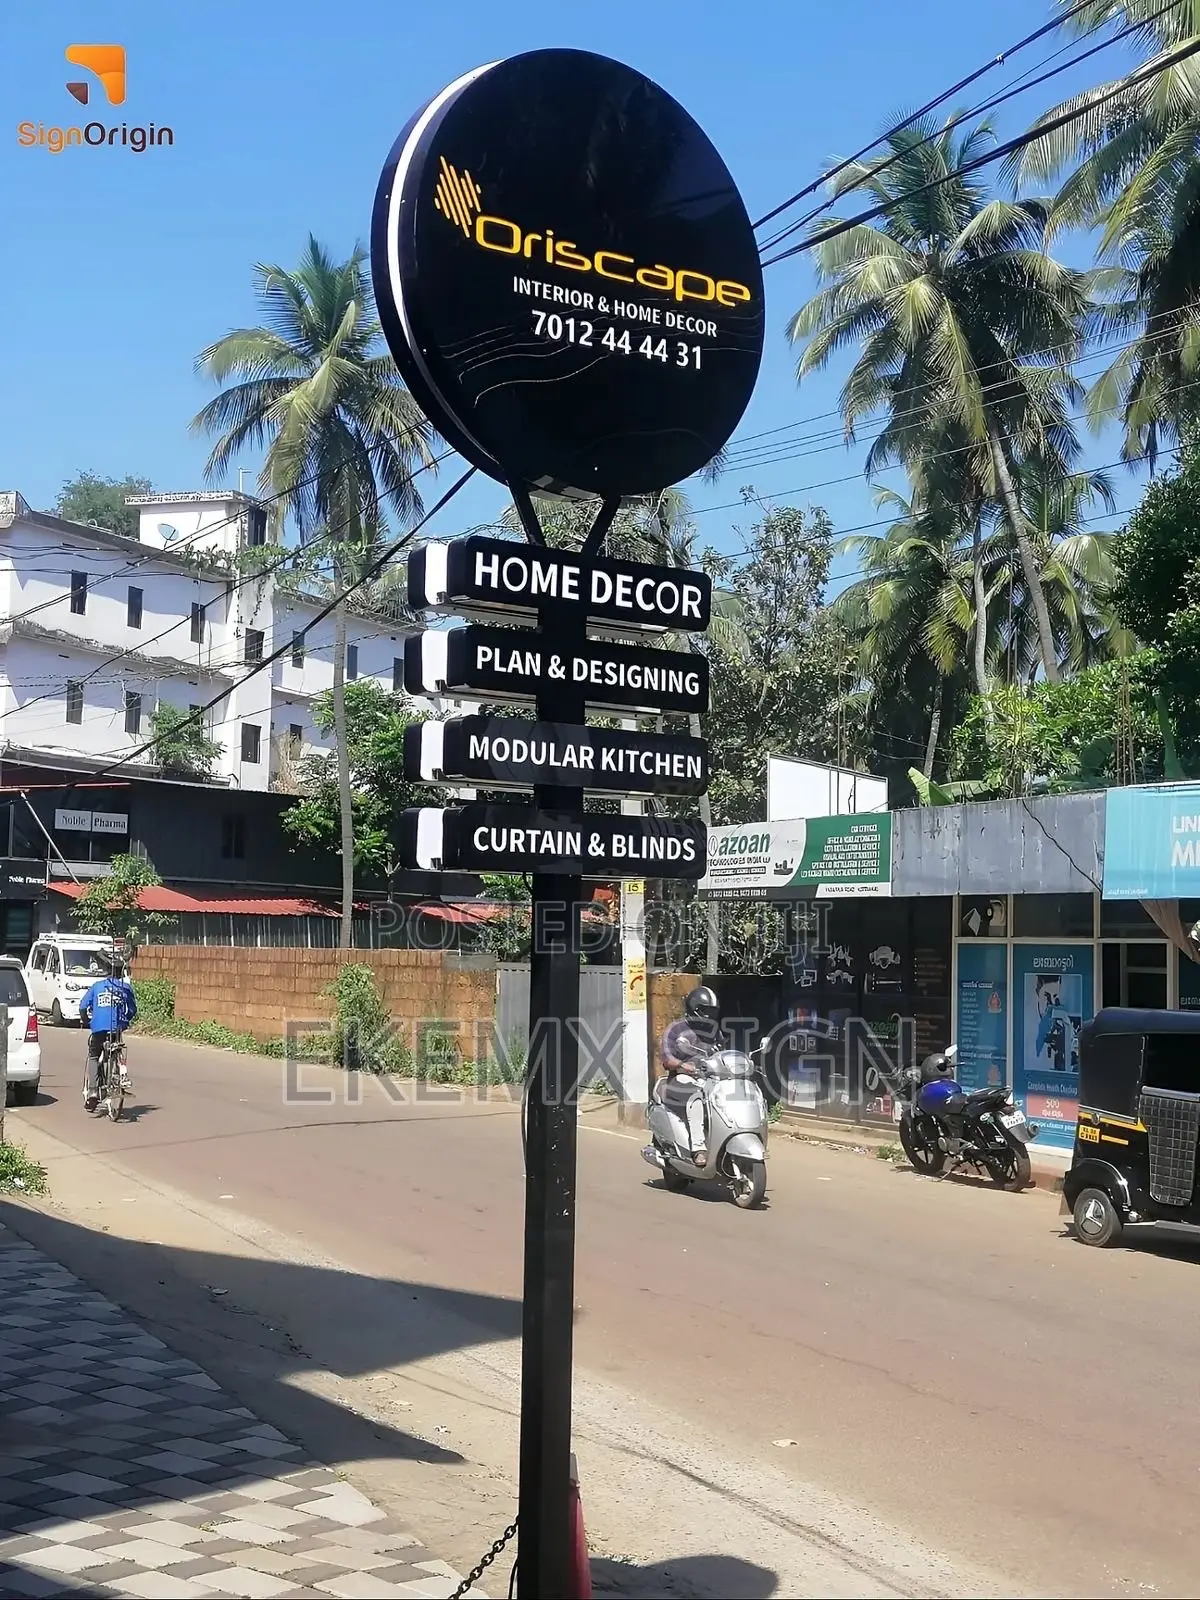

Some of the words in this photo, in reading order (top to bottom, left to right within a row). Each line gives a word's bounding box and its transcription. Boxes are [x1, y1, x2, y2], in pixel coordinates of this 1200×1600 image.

[475, 214, 752, 308] Oriscape
[512, 275, 594, 311] INTERIOR
[597, 295, 610, 314] &
[613, 299, 662, 325] HOME
[665, 311, 718, 338] DECOR
[531, 309, 594, 347] 7012
[601, 326, 632, 355] 44
[638, 334, 669, 363] 44
[675, 341, 702, 370] 31
[474, 551, 581, 601] HOME
[590, 569, 702, 619] DECOR
[476, 645, 541, 677] PLAN
[547, 654, 566, 680] &
[572, 657, 700, 696] DESIGNING
[469, 734, 595, 771] MODULAR
[601, 746, 702, 780] KITCHEN
[62, 815, 86, 827] Noble
[93, 817, 126, 830] Pharma
[473, 826, 581, 857] CURTAIN
[587, 832, 606, 858] &
[611, 834, 696, 862] BLINDS
[718, 833, 771, 857] azoan
